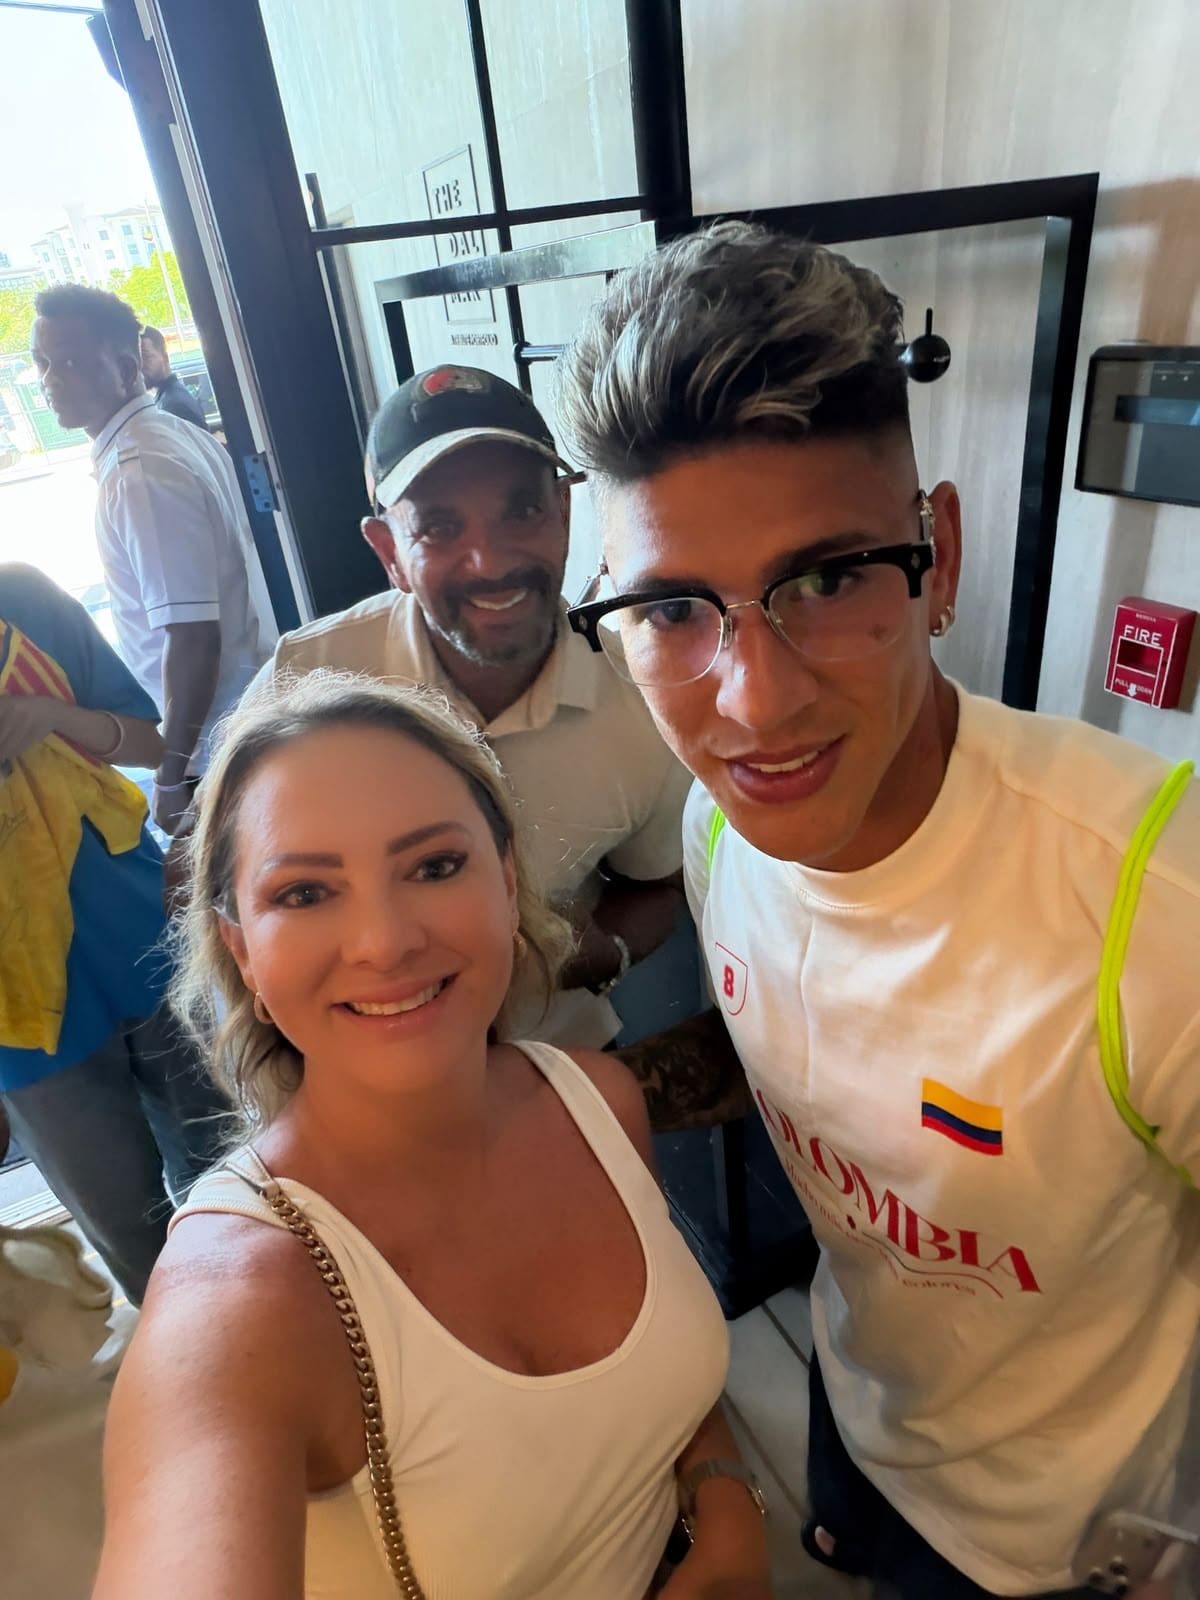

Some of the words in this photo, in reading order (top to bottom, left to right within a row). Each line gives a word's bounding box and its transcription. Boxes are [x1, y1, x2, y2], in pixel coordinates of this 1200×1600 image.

[433, 179, 462, 214] THE
[1123, 624, 1162, 647] FIRE
[756, 1088, 1043, 1294] OLOMBIA
